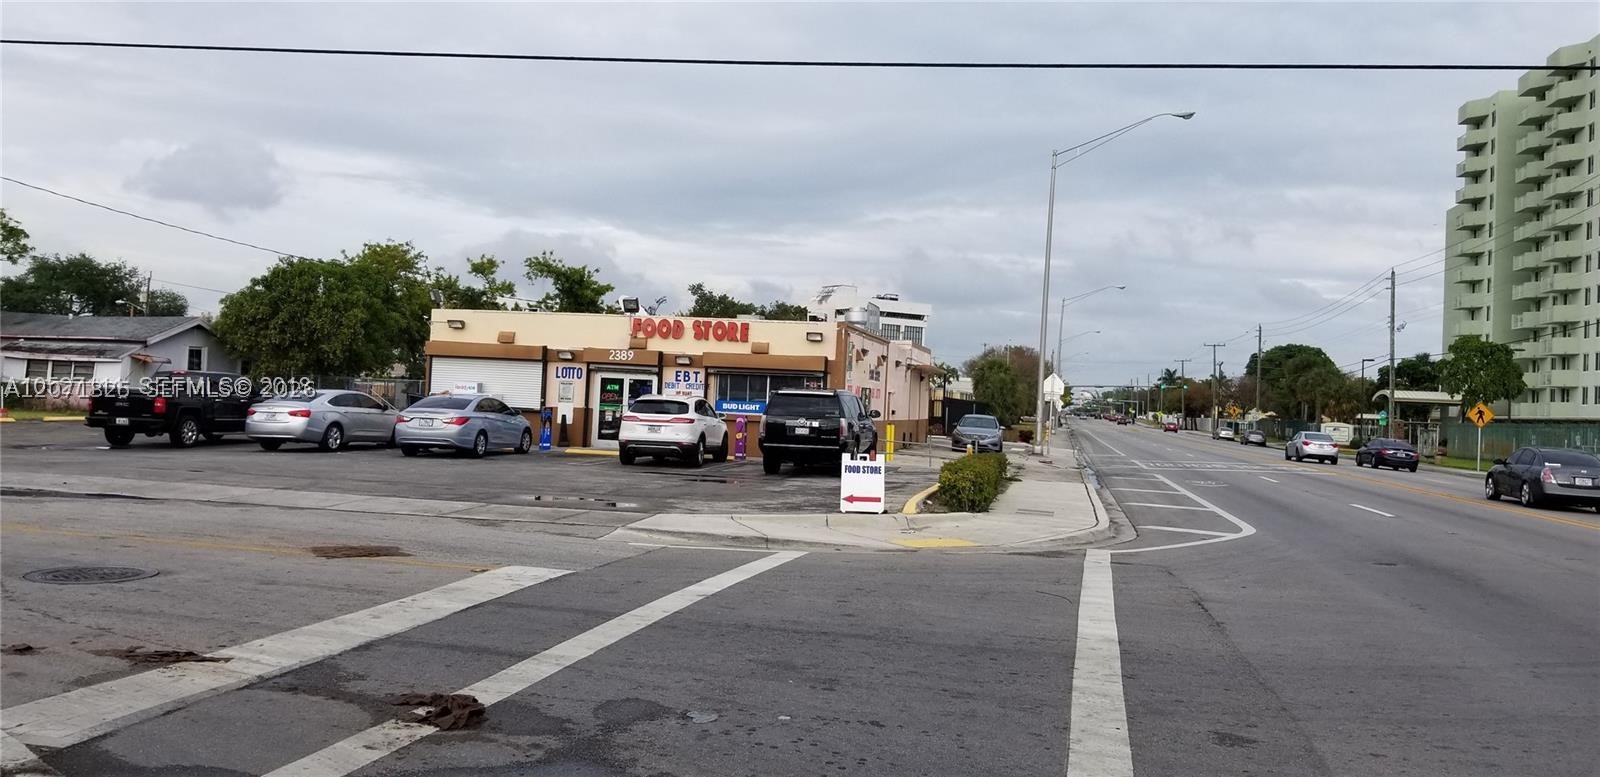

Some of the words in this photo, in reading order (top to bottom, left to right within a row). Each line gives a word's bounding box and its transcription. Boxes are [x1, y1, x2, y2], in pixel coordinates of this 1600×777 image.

[631, 318, 684, 339] FOOD
[693, 320, 749, 342] STORE
[608, 349, 634, 361] 2389
[556, 366, 583, 380] LOTTO
[844, 464, 861, 474] FOOD
[862, 465, 882, 475] STORE
